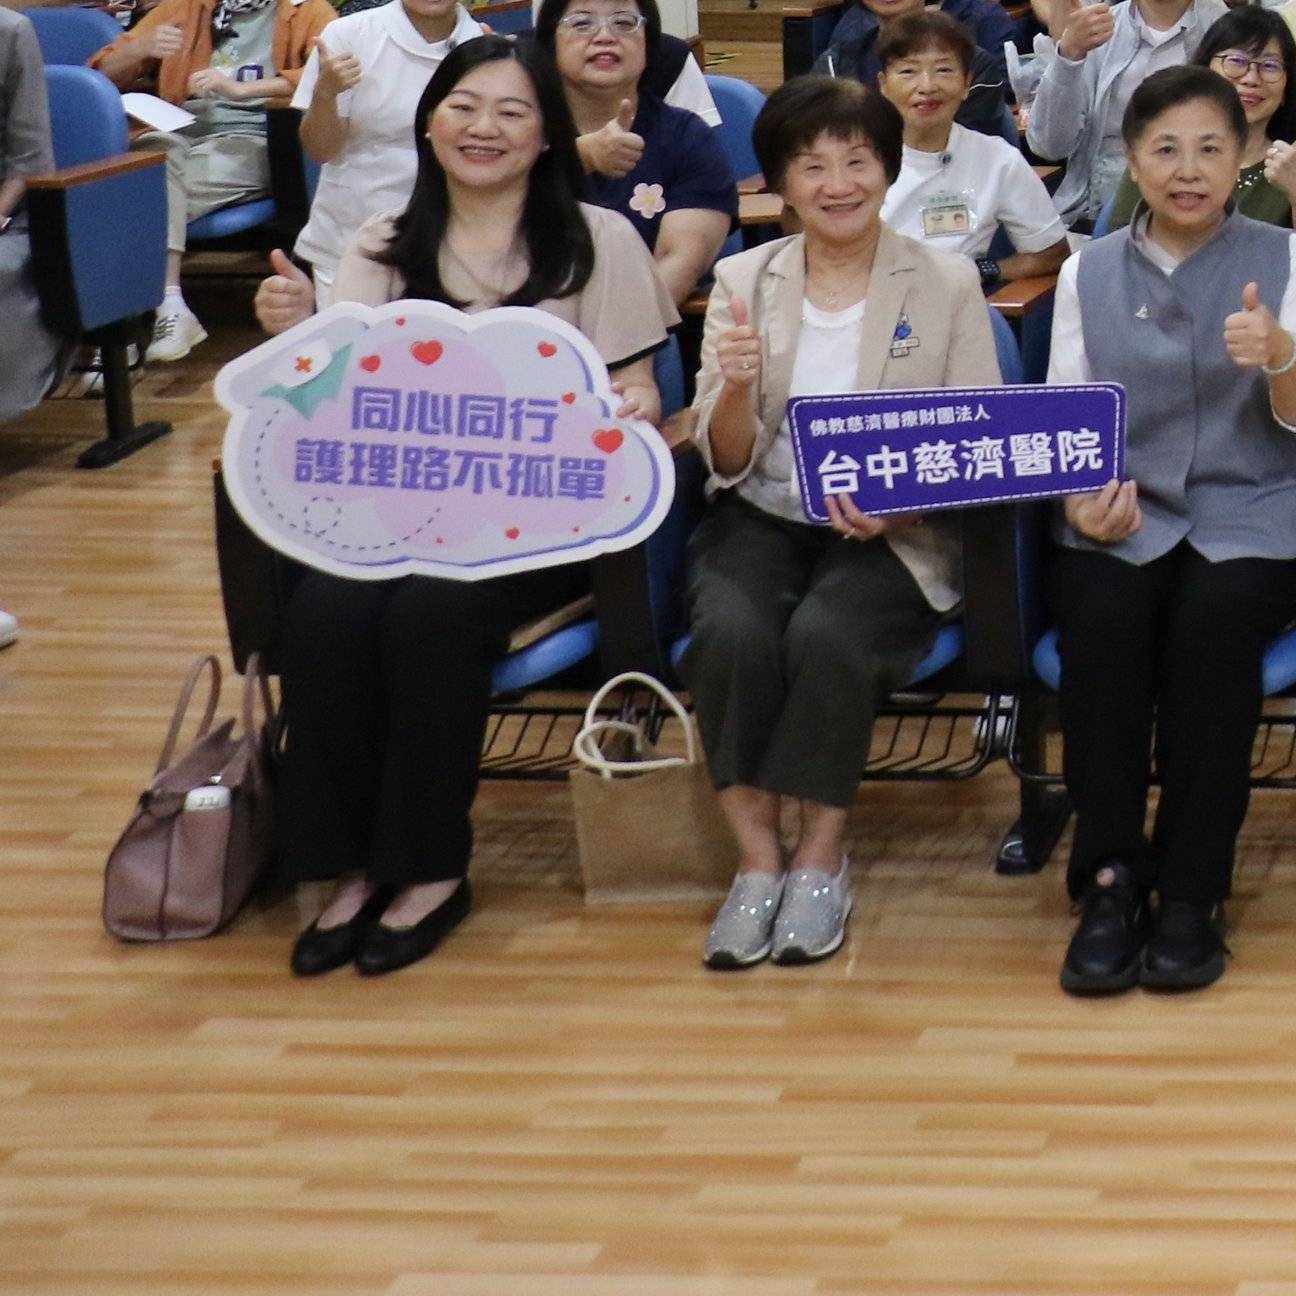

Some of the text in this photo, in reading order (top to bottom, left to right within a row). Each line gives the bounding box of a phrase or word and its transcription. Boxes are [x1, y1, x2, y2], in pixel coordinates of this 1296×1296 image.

[350, 385, 560, 445] 同心同行
[809, 403, 991, 437] 佛教慈濟醫療財團法人
[293, 437, 608, 501] 護理路不孤單
[817, 427, 1104, 497] 台中慈濟醫院
